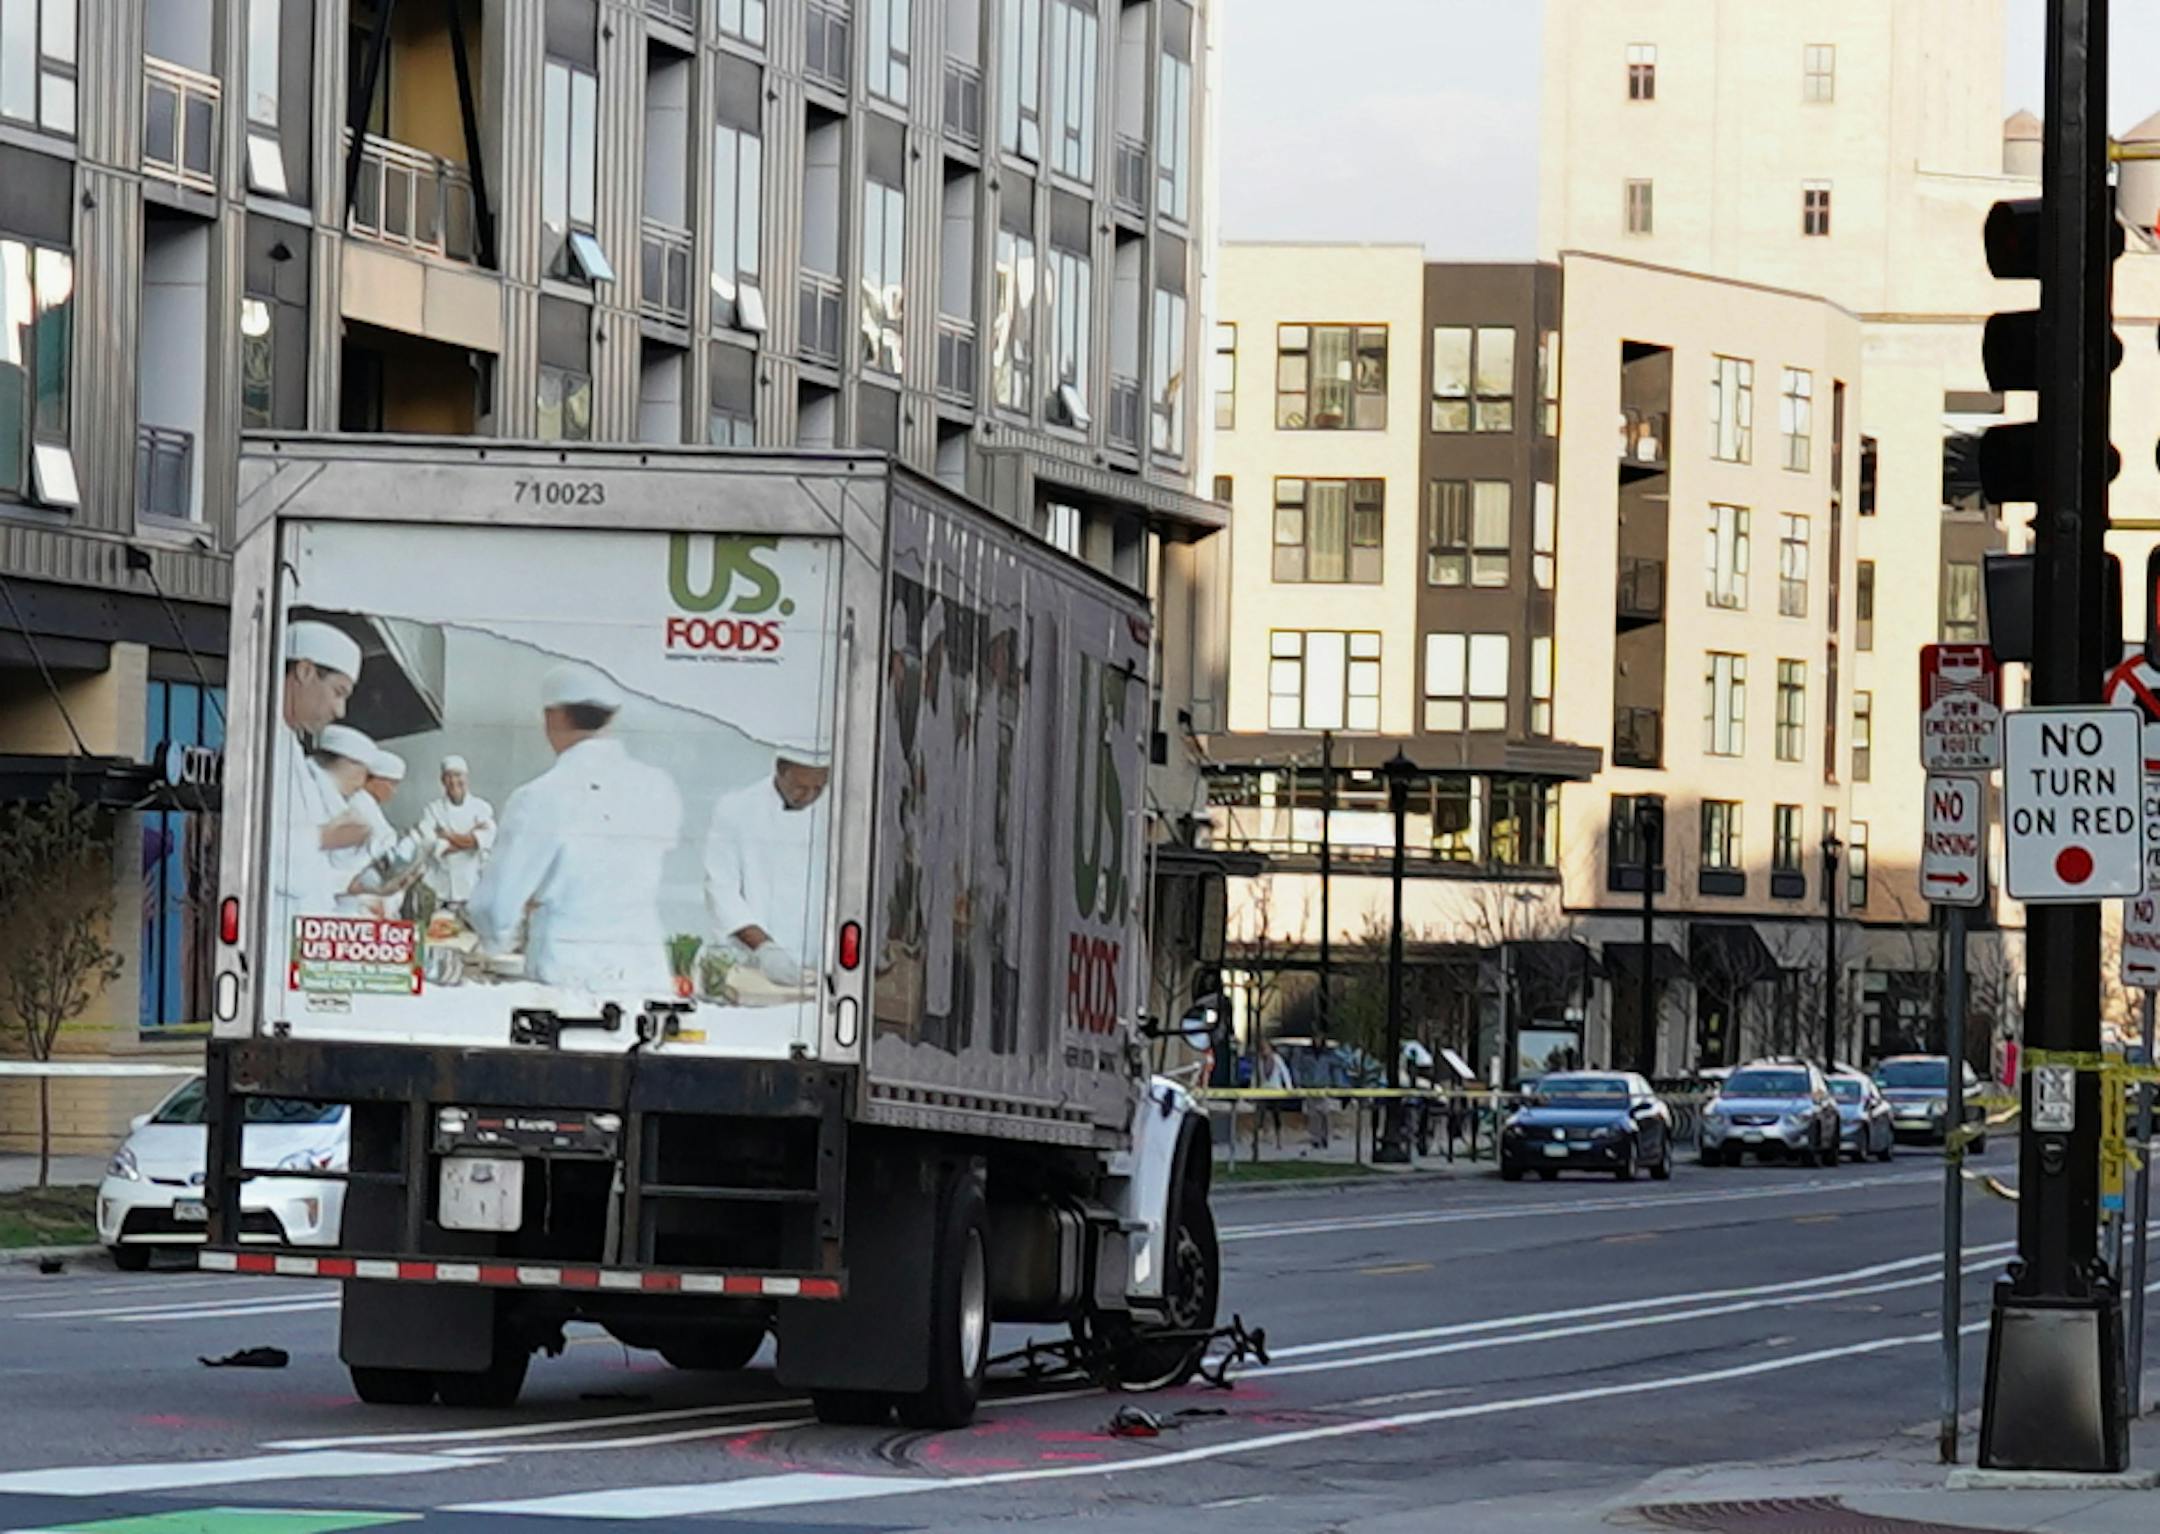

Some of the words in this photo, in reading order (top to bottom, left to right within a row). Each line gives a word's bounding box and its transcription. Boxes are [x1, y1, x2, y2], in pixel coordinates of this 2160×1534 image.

[514, 480, 605, 505] 710023
[666, 617, 782, 652] FOODS
[2041, 722, 2102, 757] NO
[2030, 767, 2115, 796] TURN
[1933, 790, 1963, 822] NO
[2013, 807, 2056, 836] ON
[2072, 806, 2134, 835] RED
[304, 920, 375, 941] DRIVE
[380, 922, 412, 943] for
[302, 940, 332, 959] US
[335, 941, 408, 962] FOODS
